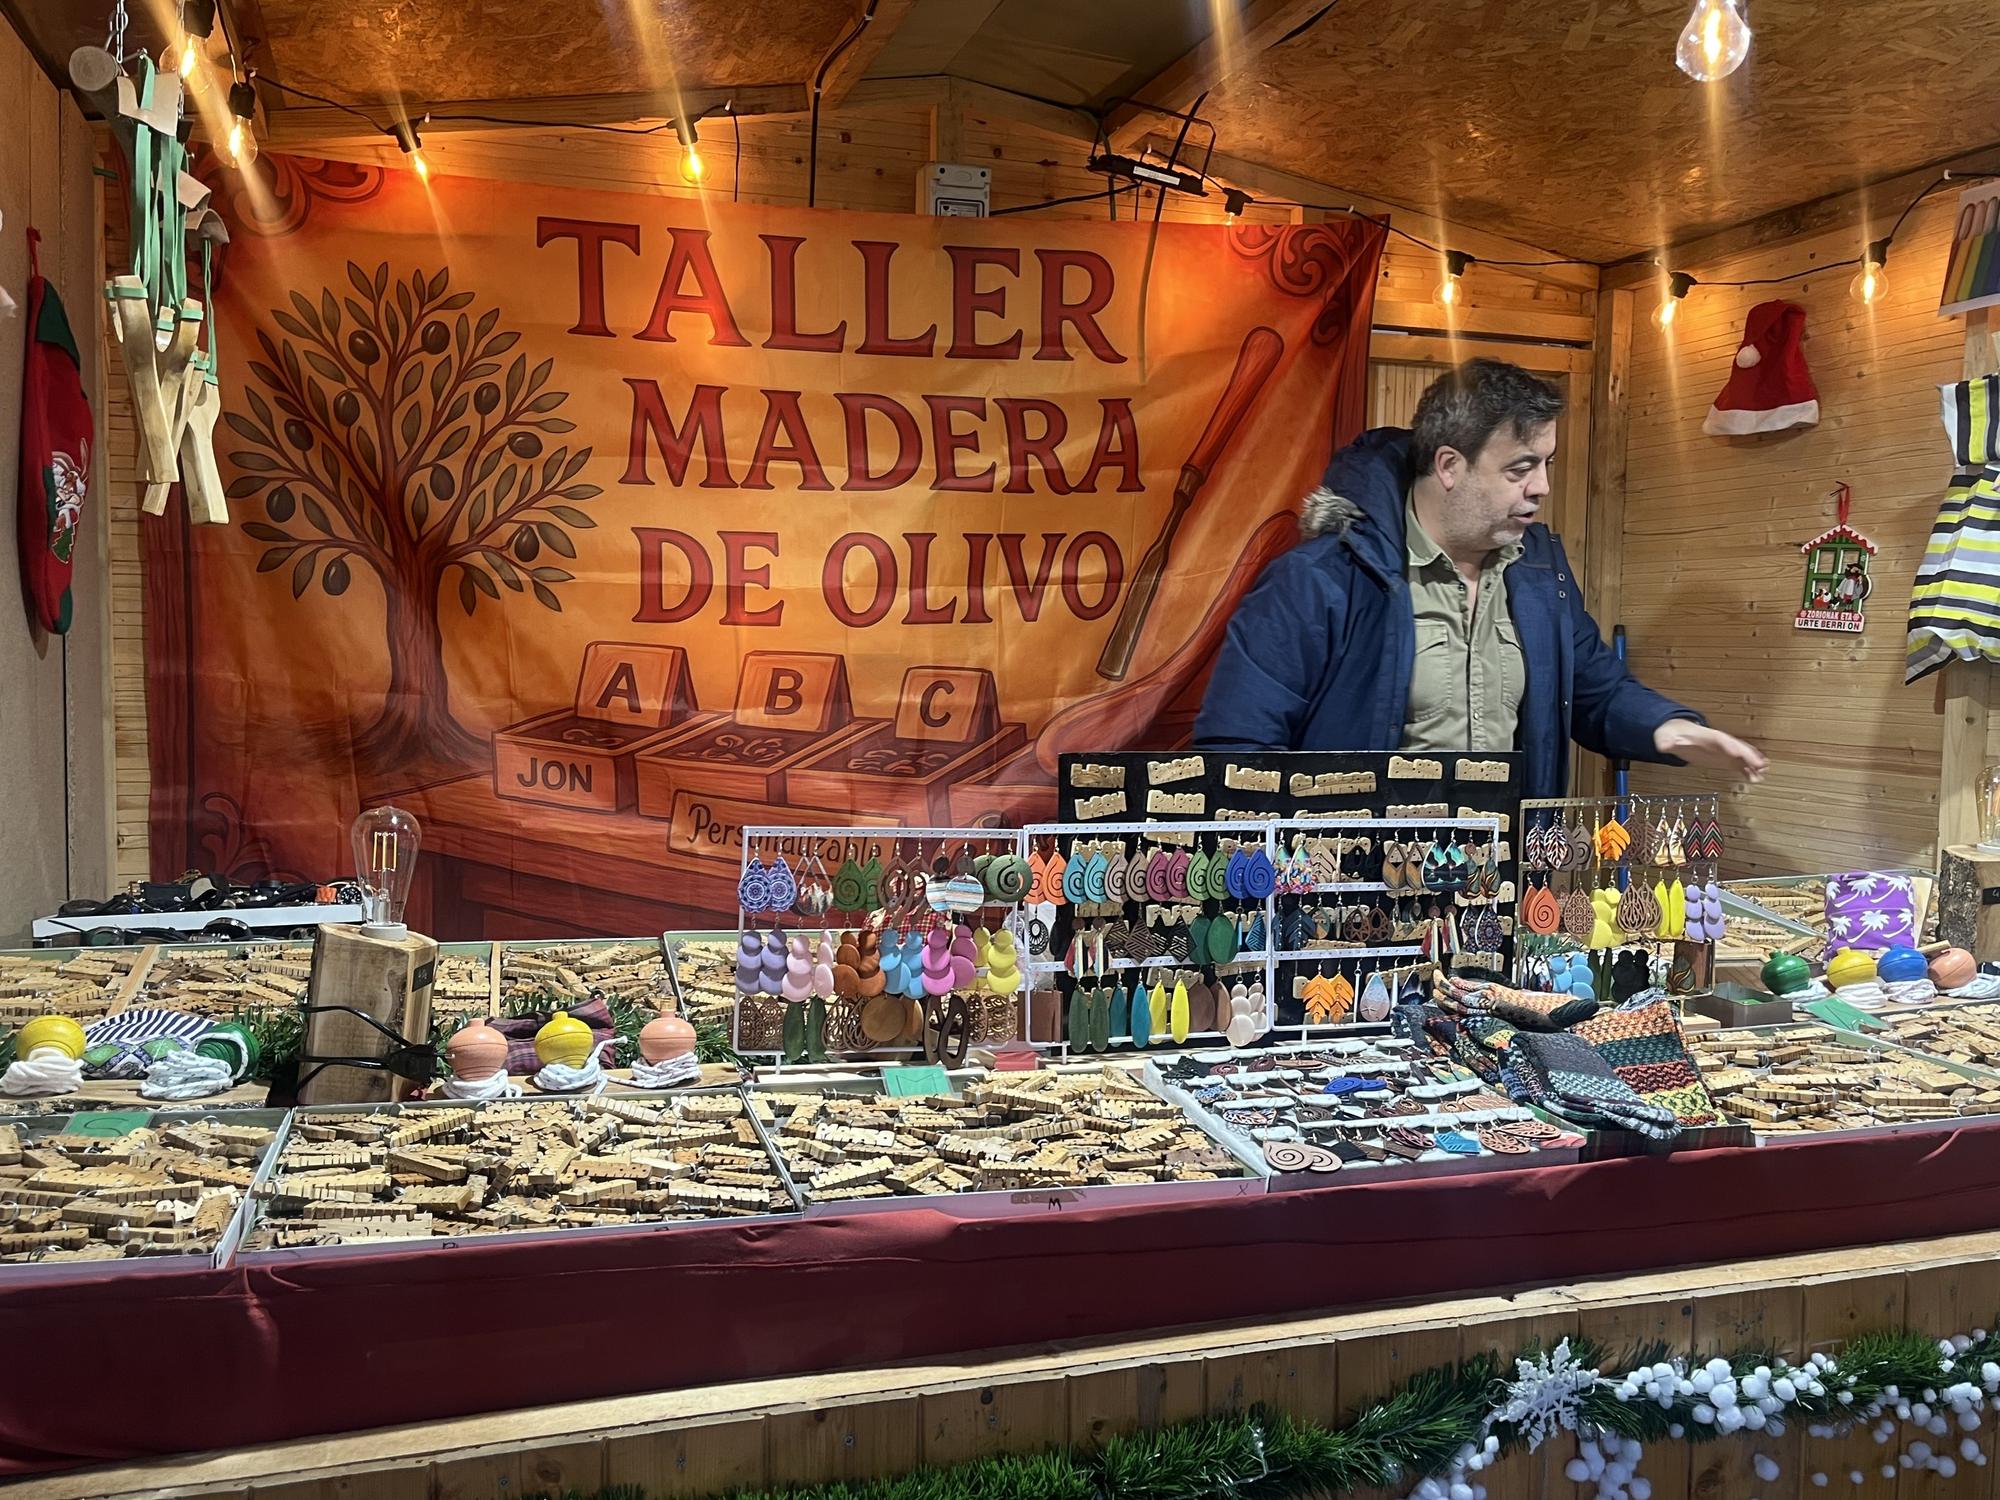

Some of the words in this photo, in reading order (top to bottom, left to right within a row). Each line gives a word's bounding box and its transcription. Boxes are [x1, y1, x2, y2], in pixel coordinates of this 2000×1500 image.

[537, 216, 1127, 364] TALLER
[618, 378, 1146, 495] MADERA
[630, 527, 785, 626] DE
[821, 531, 1124, 628] OLIVO
[1798, 619, 1819, 628] URTE
[1821, 620, 1846, 629] BERRI
[1847, 622, 1860, 630] ON
[1807, 610, 1839, 620] ZORIONAK
[1841, 612, 1853, 621] ETA
[595, 662, 641, 713] A
[763, 667, 804, 716] B
[920, 679, 955, 728] C
[516, 757, 592, 793] JON
